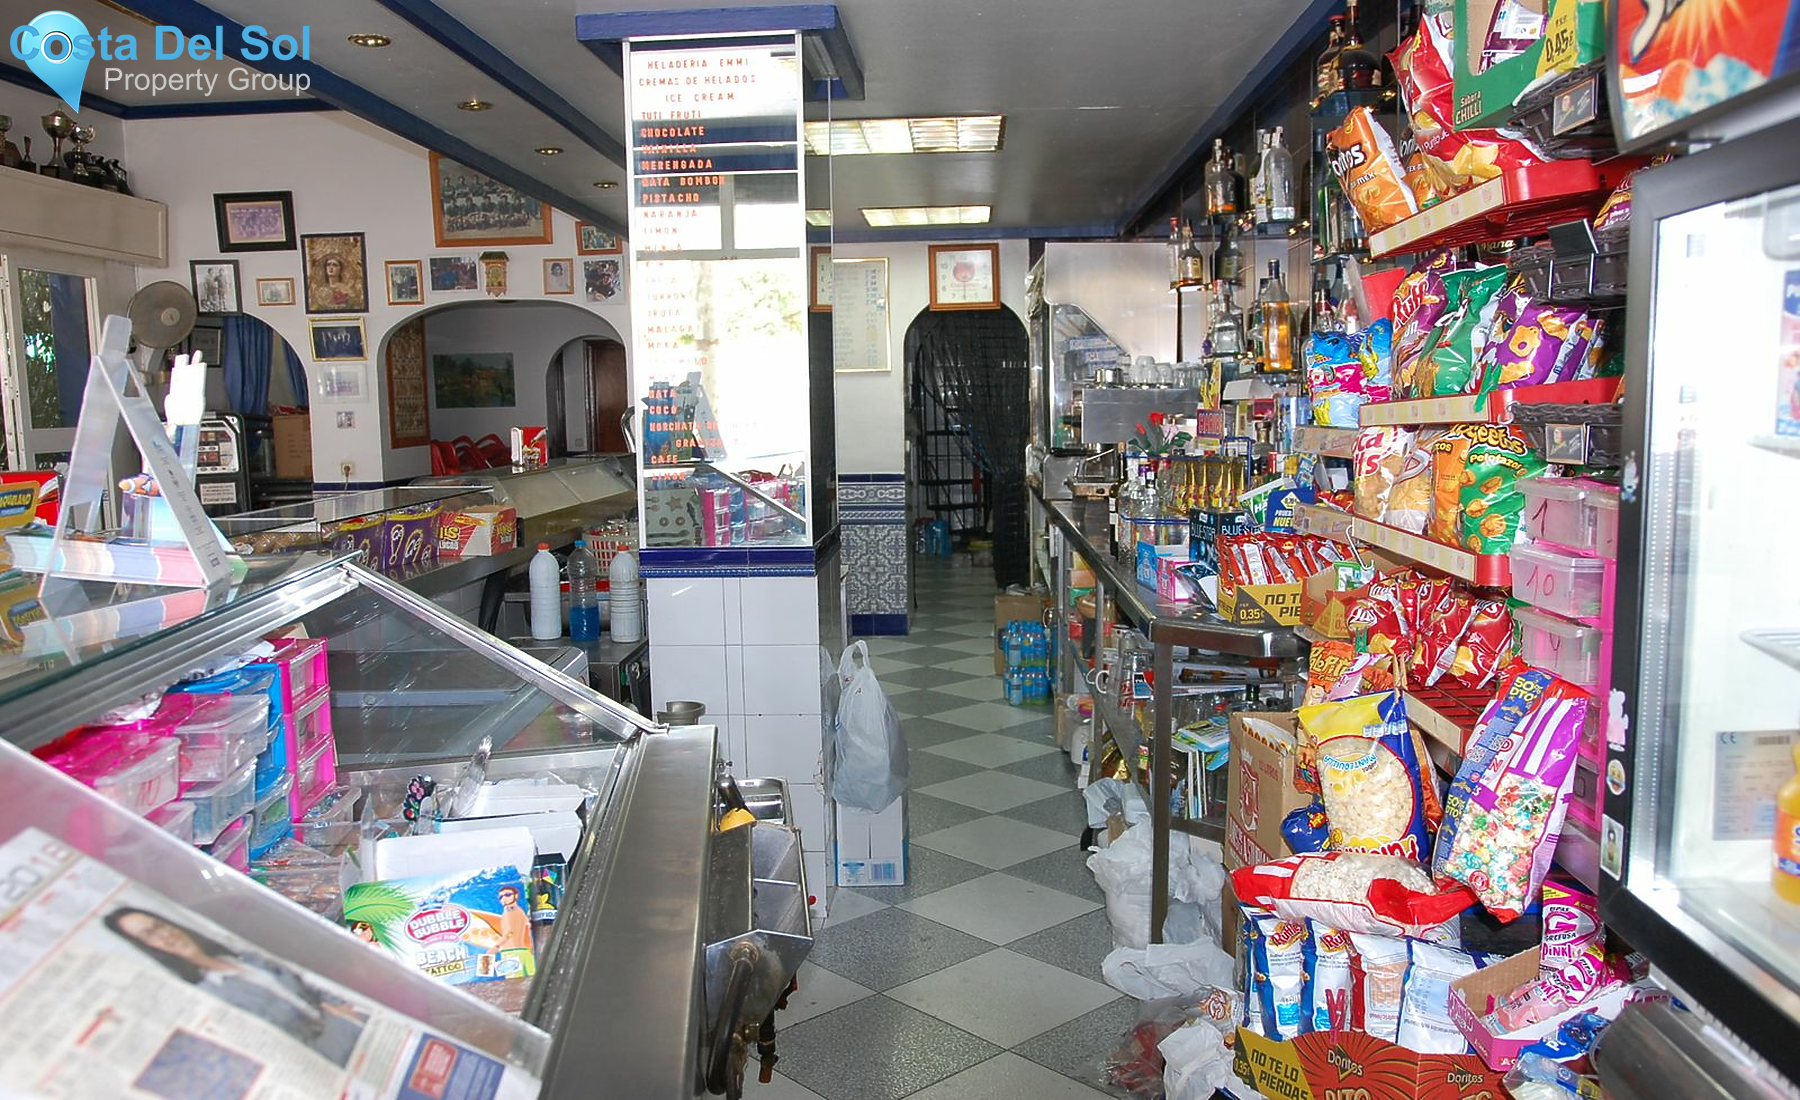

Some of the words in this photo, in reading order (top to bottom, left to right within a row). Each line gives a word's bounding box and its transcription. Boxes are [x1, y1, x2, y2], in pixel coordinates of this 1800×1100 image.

[647, 59, 708, 70] HELADERIA
[639, 78, 680, 87] CREMAS
[686, 77, 698, 85] DE
[704, 75, 756, 84] HELADOS
[666, 94, 682, 102] ICE
[694, 93, 735, 102] CREAM
[641, 111, 662, 121] TUTI
[670, 110, 702, 120] FRUTI
[1456, 101, 1482, 125] CHILLI
[641, 126, 705, 138] CHOCOLATE
[641, 159, 713, 171] MERENGADA
[680, 175, 725, 187] BOMBON
[642, 193, 700, 204] PISTACHO
[643, 210, 698, 218] NARANJA
[649, 405, 677, 415] COCO
[649, 420, 701, 432] HORCHATA
[651, 454, 678, 464] CAFE
[652, 473, 686, 482] LIMON
[1264, 594, 1285, 606] NO
[1290, 593, 1300, 604] T
[410, 909, 462, 929] DUBBLE
[413, 918, 466, 938] BUBBLE
[416, 946, 468, 966] BEACH
[1251, 1048, 1267, 1067] NO
[1269, 1056, 1283, 1075] TE
[1284, 1064, 1299, 1083] LO
[1327, 1049, 1364, 1077] Doritos
[1447, 1072, 1484, 1084] Doritos
[1259, 1069, 1309, 1100] PIERDAS
